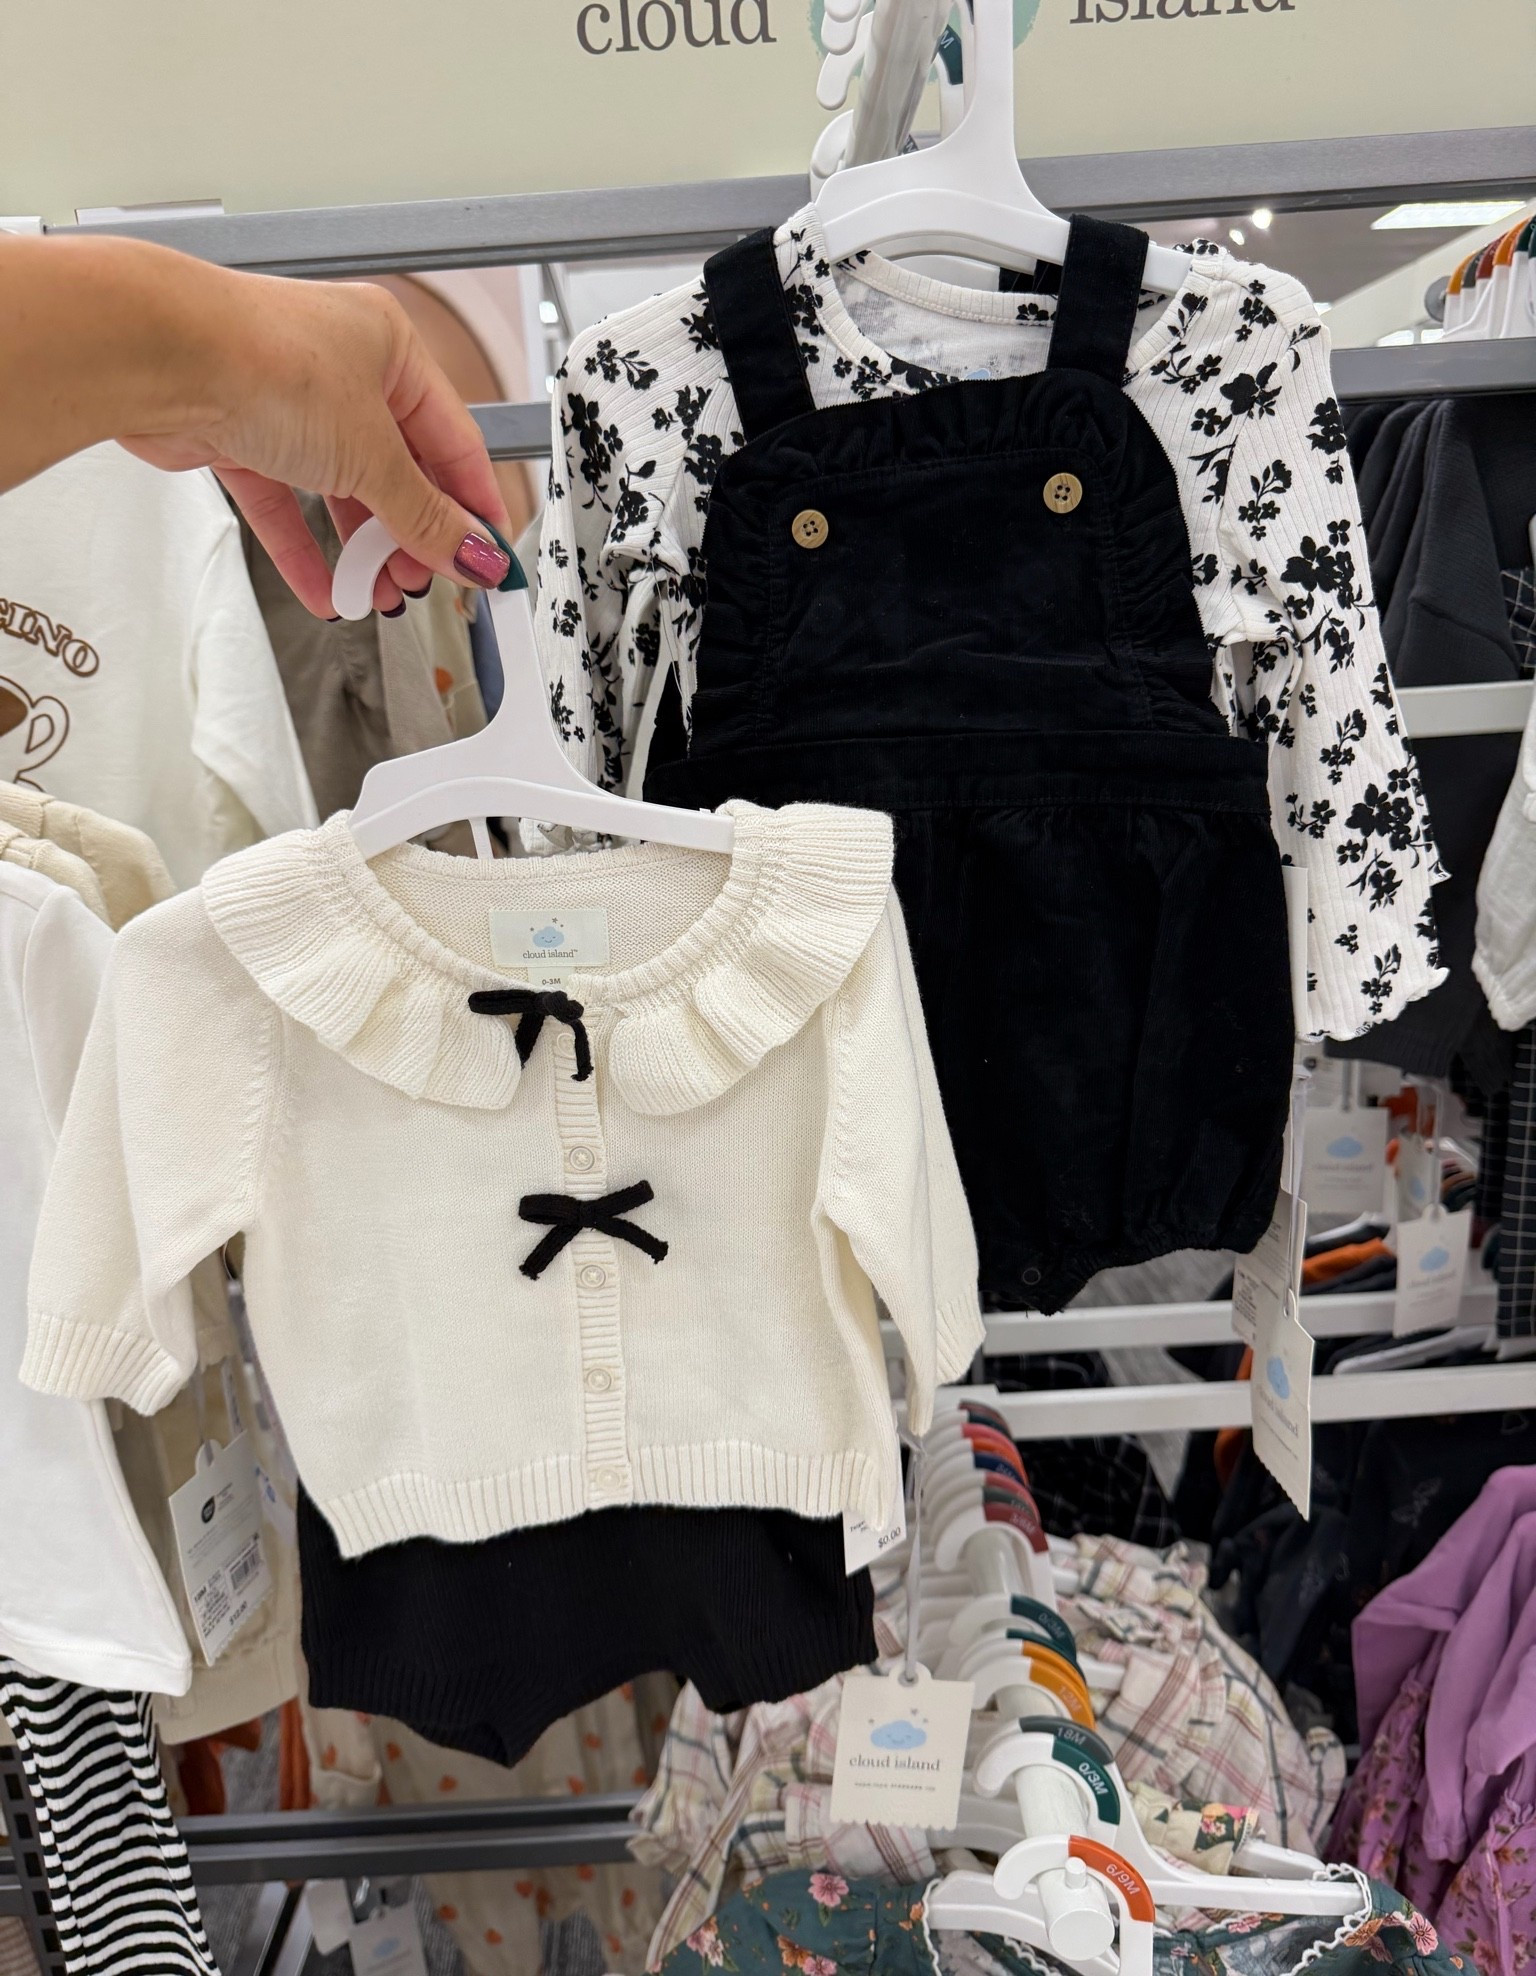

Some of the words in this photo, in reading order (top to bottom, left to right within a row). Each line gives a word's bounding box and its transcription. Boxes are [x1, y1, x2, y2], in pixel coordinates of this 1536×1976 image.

[577, 0, 777, 55] cloud
[522, 950, 546, 959] cloud
[542, 978, 561, 986] 0-3M
[878, 1526, 901, 1549] $0.00
[1059, 1685, 1083, 1713] 12M
[1057, 1726, 1086, 1746] 18M
[849, 1753, 890, 1768] cloud
[895, 1755, 940, 1771] island
[1078, 1762, 1109, 1795] 0/3M
[1105, 1863, 1141, 1895] 6/9M
